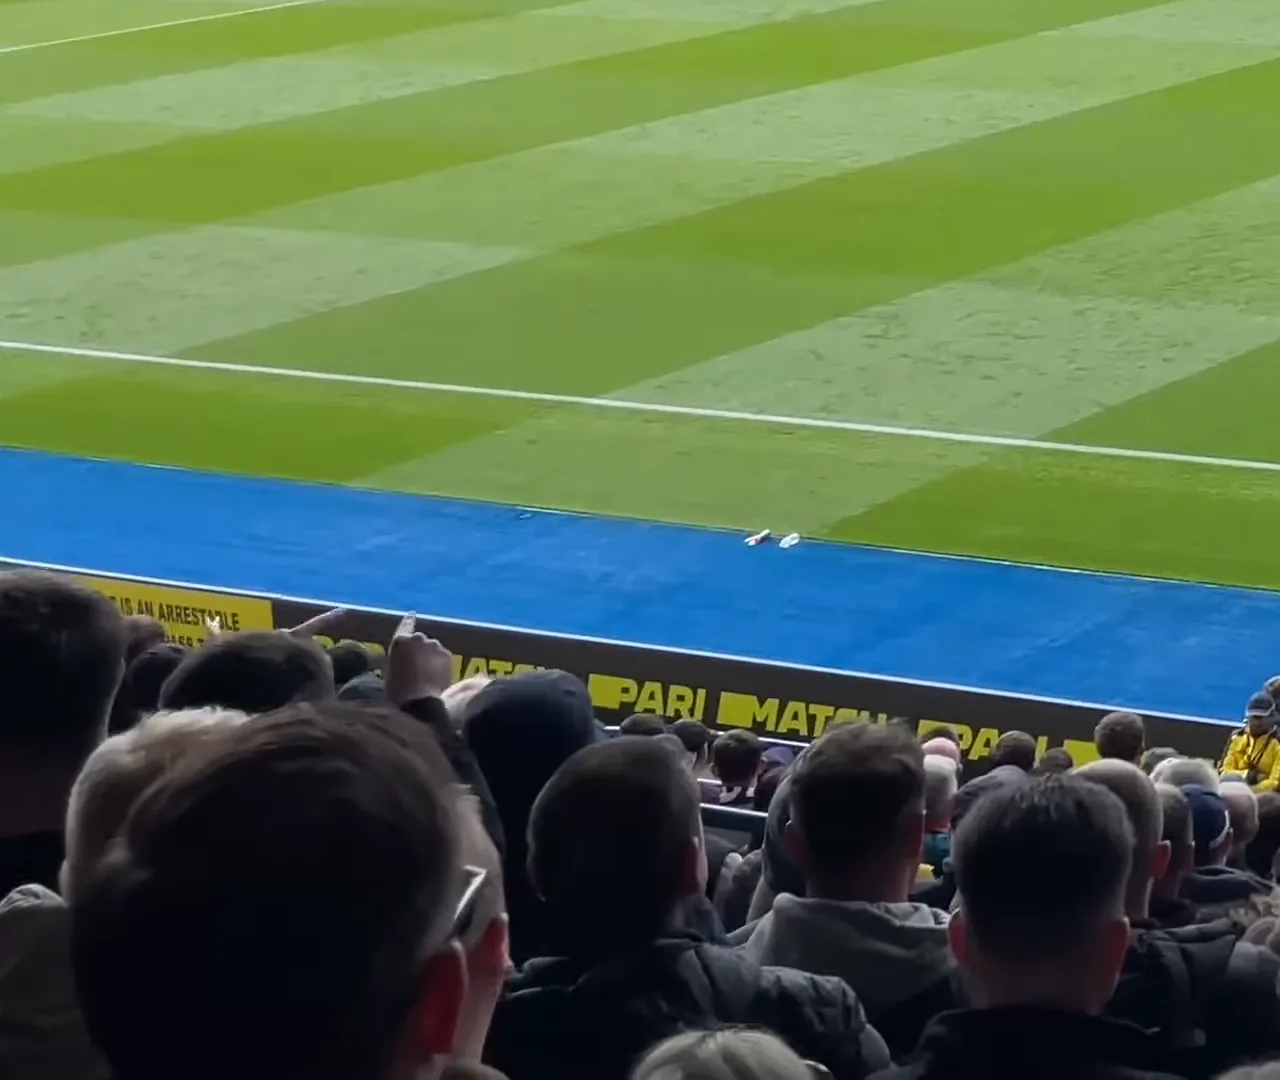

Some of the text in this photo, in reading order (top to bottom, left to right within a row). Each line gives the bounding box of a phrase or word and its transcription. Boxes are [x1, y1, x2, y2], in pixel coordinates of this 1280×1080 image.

[120, 597, 133, 616] IS
[137, 600, 154, 617] AN
[616, 677, 706, 722] PARI
